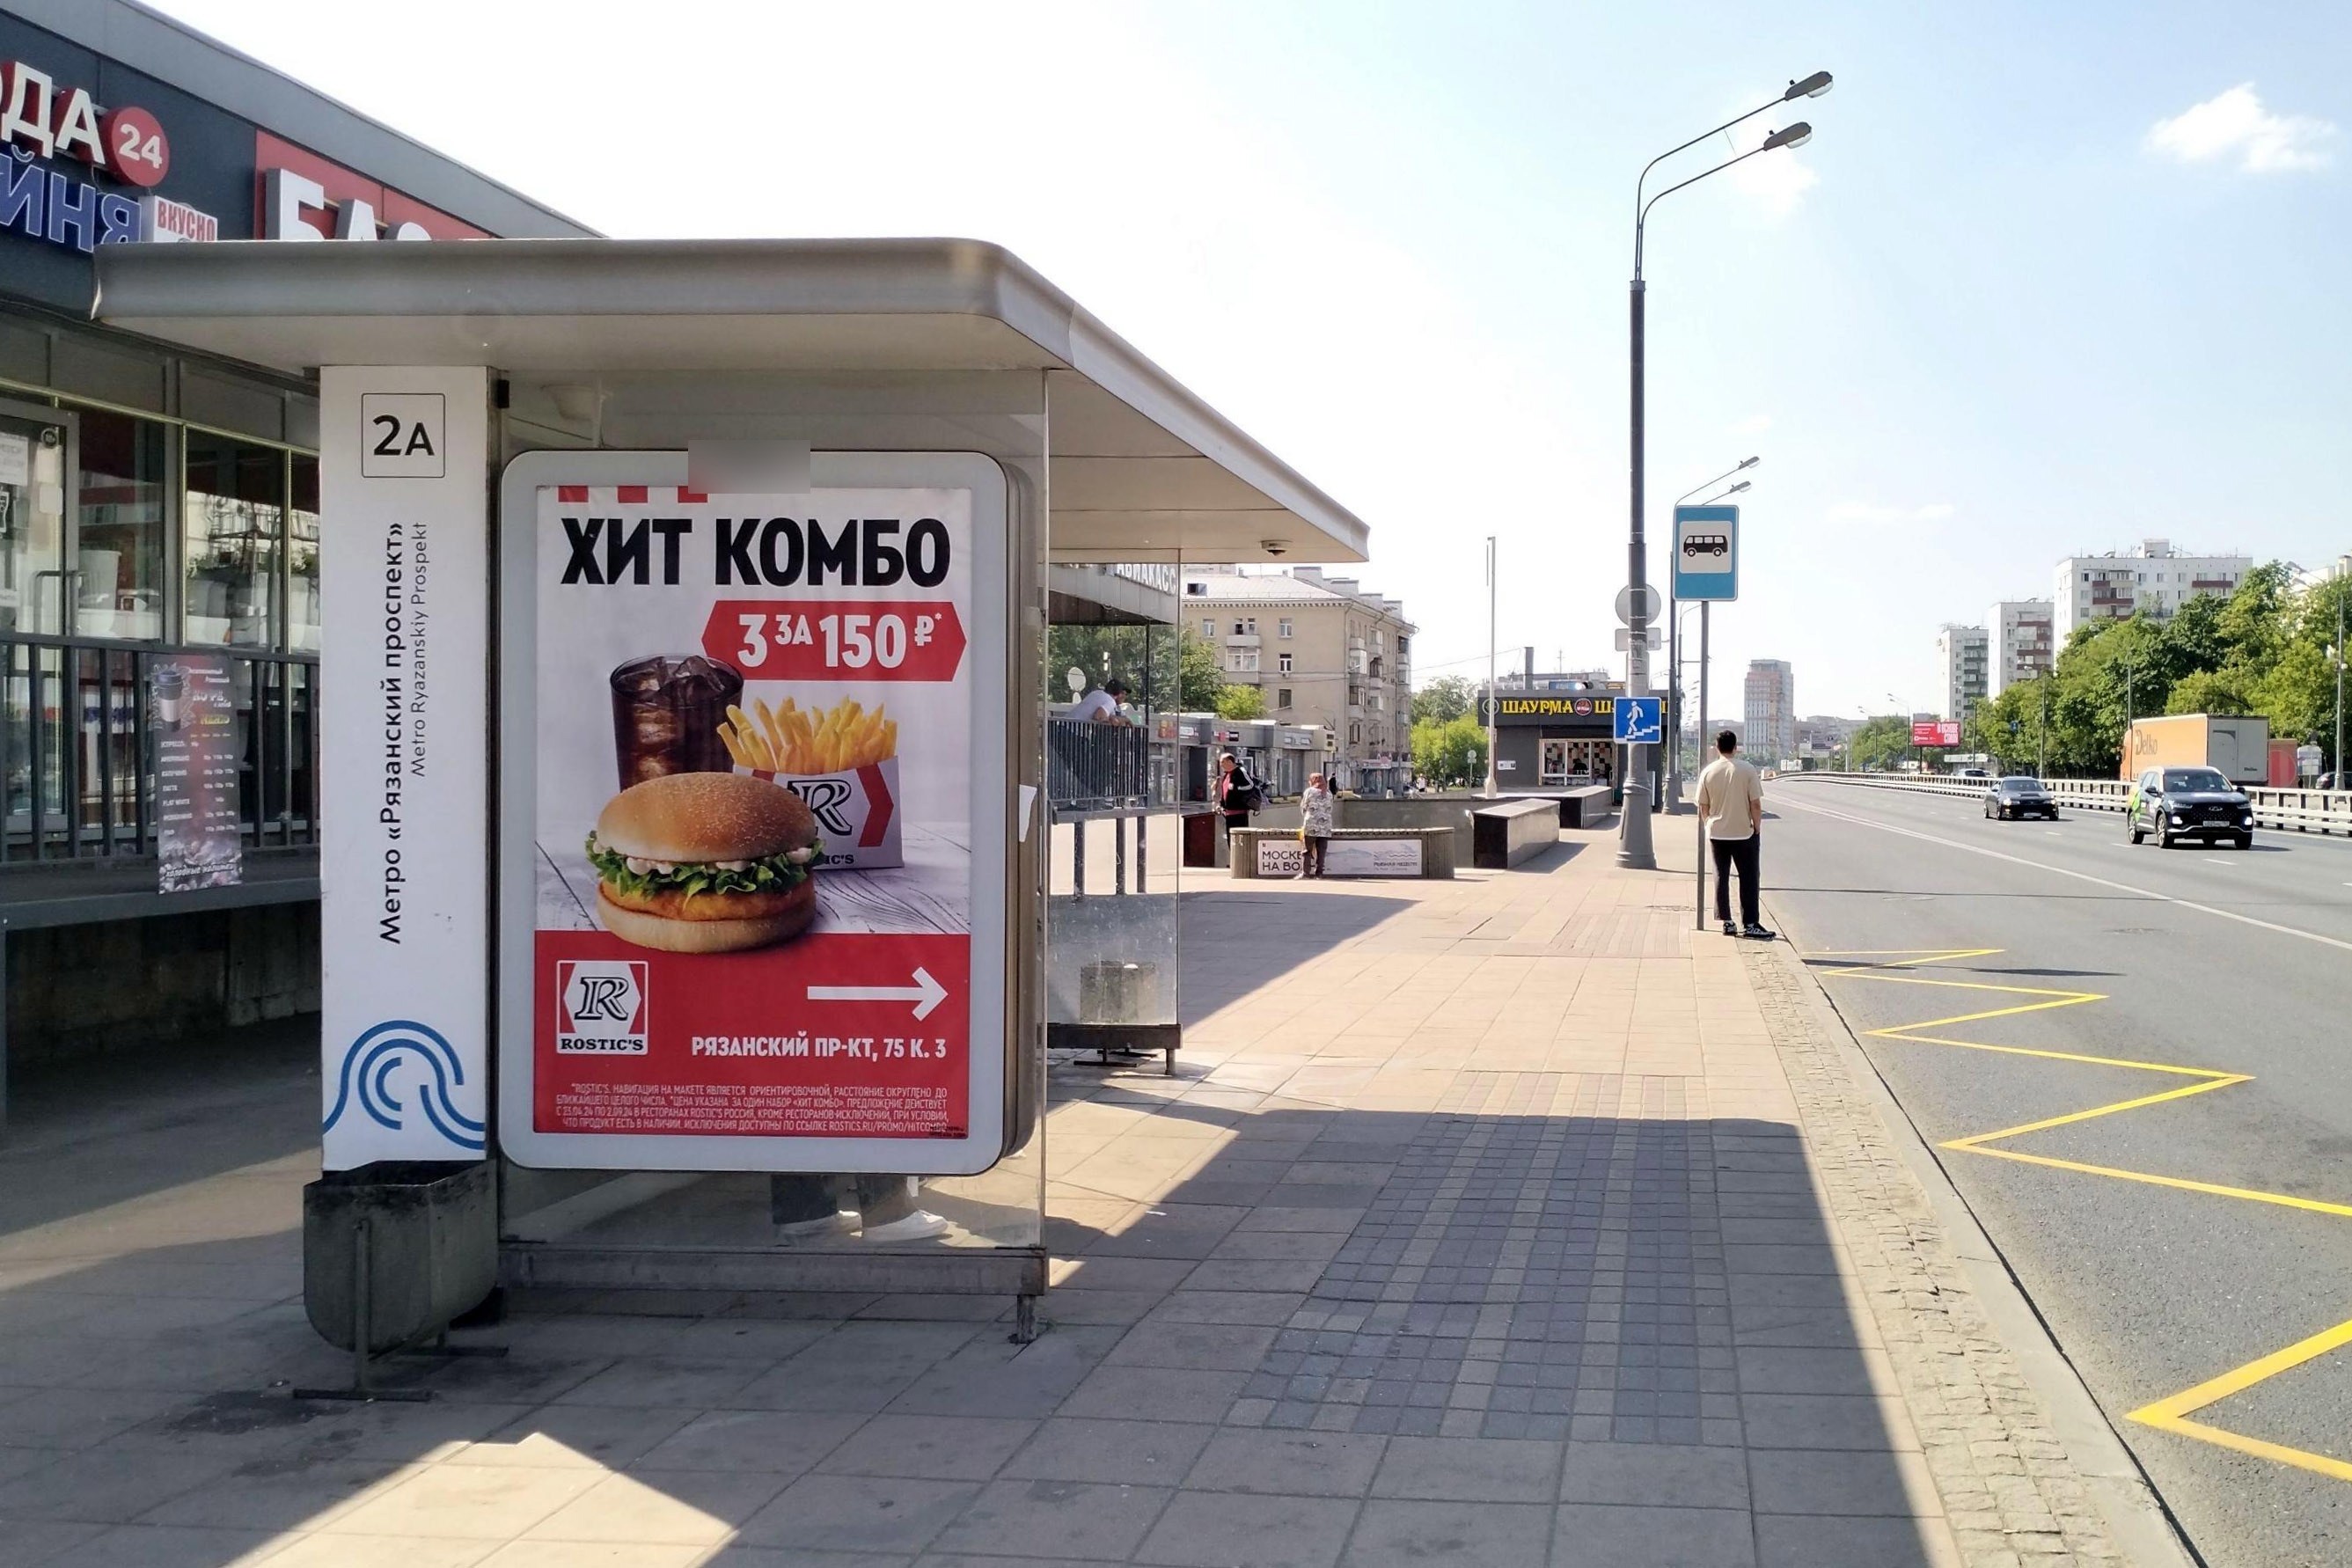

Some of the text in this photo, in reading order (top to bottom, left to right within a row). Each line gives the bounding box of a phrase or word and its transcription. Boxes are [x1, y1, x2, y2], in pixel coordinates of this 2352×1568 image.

[0, 61, 163, 169] ДА 24
[157, 201, 216, 242] ВКУСНО
[561, 517, 951, 587] ХИТ КОМБО
[410, 522, 430, 777] Metro Ryazanskiy Prospekt
[737, 614, 768, 668] 3
[818, 614, 907, 669] 150
[1502, 700, 1574, 715] ШАУРМА
[379, 522, 407, 944] Метро «Рязанский проспект»
[2135, 729, 2158, 755] Delko
[1262, 861, 1280, 871] НА
[574, 977, 629, 1021] R
[561, 1038, 643, 1051] ROSTIC'S
[692, 1030, 946, 1062] РЯЗАНСКИЙ ПР-КТ, 75 К. 3
[611, 1095, 640, 1105] ЦЕЛОГО
[695, 1096, 729, 1107] УКАЗАНА
[731, 1097, 742, 1107] ЗА
[744, 1097, 765, 1108] ОДИН
[766, 1097, 792, 1107] НАБОР
[847, 1098, 904, 1110] ПРЕДЛОЖЕНИЕ
[905, 1099, 948, 1110] ДЕЙСТВУЕТ
[613, 1084, 659, 1095] НАВИГАЦИЯ
[661, 1085, 672, 1094] НА
[674, 1085, 705, 1095] МАКЕТЕ
[707, 1085, 746, 1095] ЯВЛЯЕТСЯ
[834, 1087, 884, 1097] РАССТОЯНИЕ
[887, 1087, 932, 1098] ОКРУГЛЕНО
[935, 1088, 948, 1098] ДО
[563, 1117, 578, 1127] ЧТО
[580, 1117, 615, 1129] ПРОДУКТ
[616, 1118, 634, 1128] ЕСТЬ
[685, 1119, 737, 1130] ИСКЛЮЧЕНИЯ
[738, 1120, 782, 1132] ДОСТУПНЫ
[783, 1120, 794, 1131] ПО
[795, 1121, 827, 1132] ССЫЛКЕ
[595, 1107, 605, 1116] ПО
[641, 1107, 688, 1117] РЕСТОРАНАХ
[758, 1109, 783, 1119] КРОМЕ
[893, 1110, 910, 1120] ПРИ
